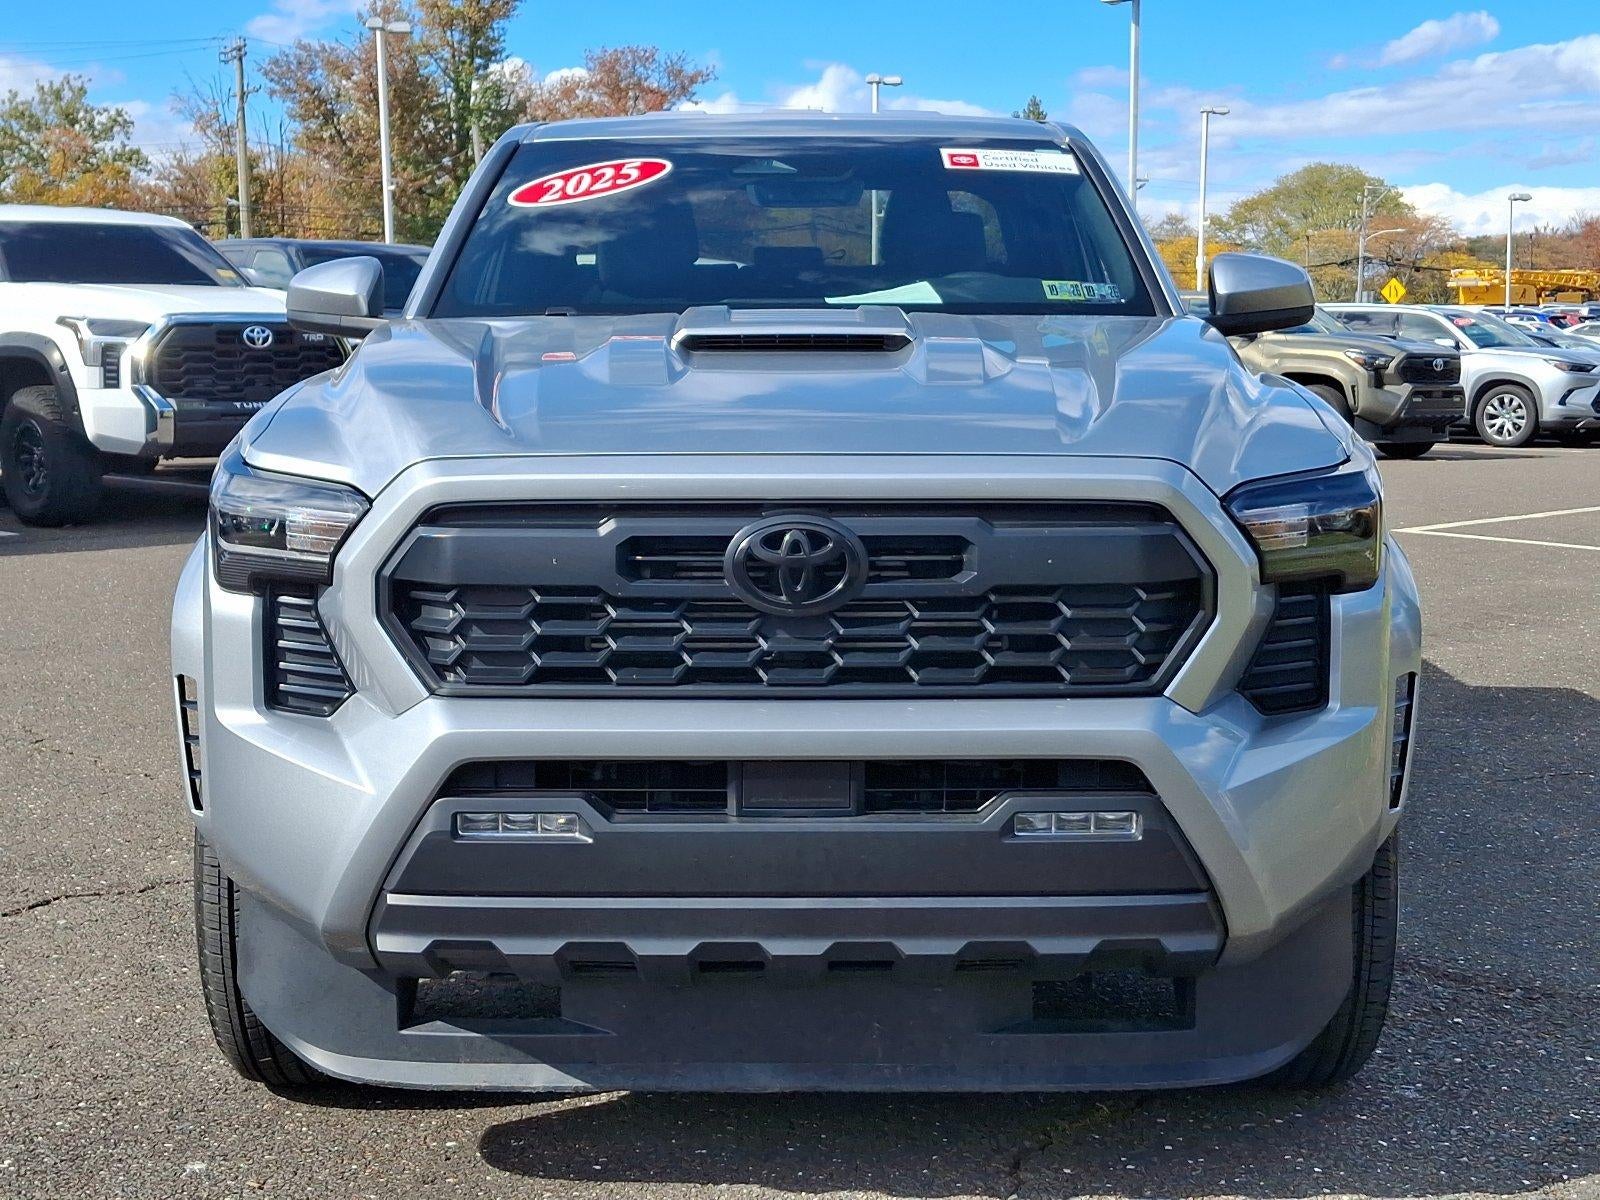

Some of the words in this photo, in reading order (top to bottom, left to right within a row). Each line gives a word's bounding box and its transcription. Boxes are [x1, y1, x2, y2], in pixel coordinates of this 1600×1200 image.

[982, 153, 1039, 163] Certified
[1020, 163, 1073, 172] Vehicles
[538, 161, 642, 202] 2025
[1047, 284, 1059, 296] 10
[1084, 285, 1096, 298] 10
[302, 333, 324, 341] TRD
